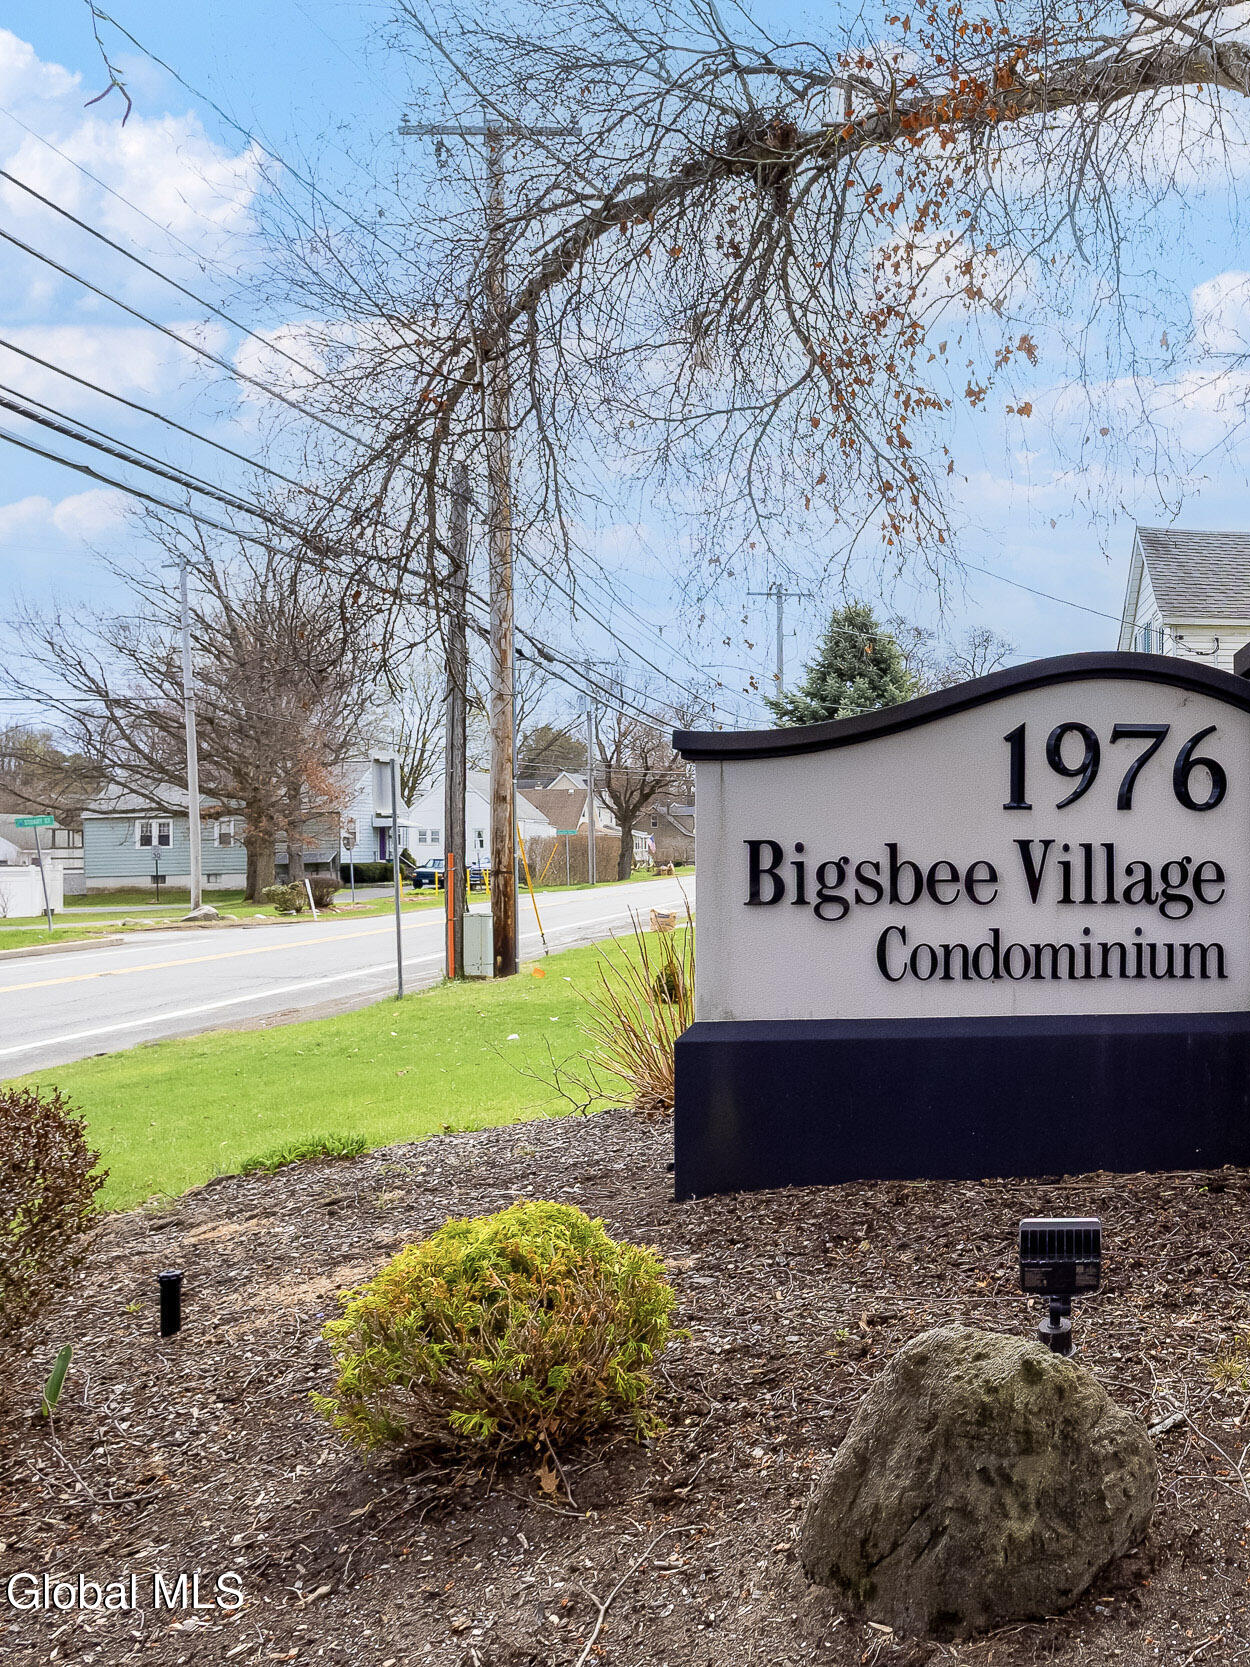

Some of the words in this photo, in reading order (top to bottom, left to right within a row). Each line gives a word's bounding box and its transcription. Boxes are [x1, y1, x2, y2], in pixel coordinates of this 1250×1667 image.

[1003, 722, 1228, 811] 1976
[743, 839, 999, 922] Bigsbee
[1013, 839, 1226, 920] Village
[876, 925, 1229, 981] Condominium
